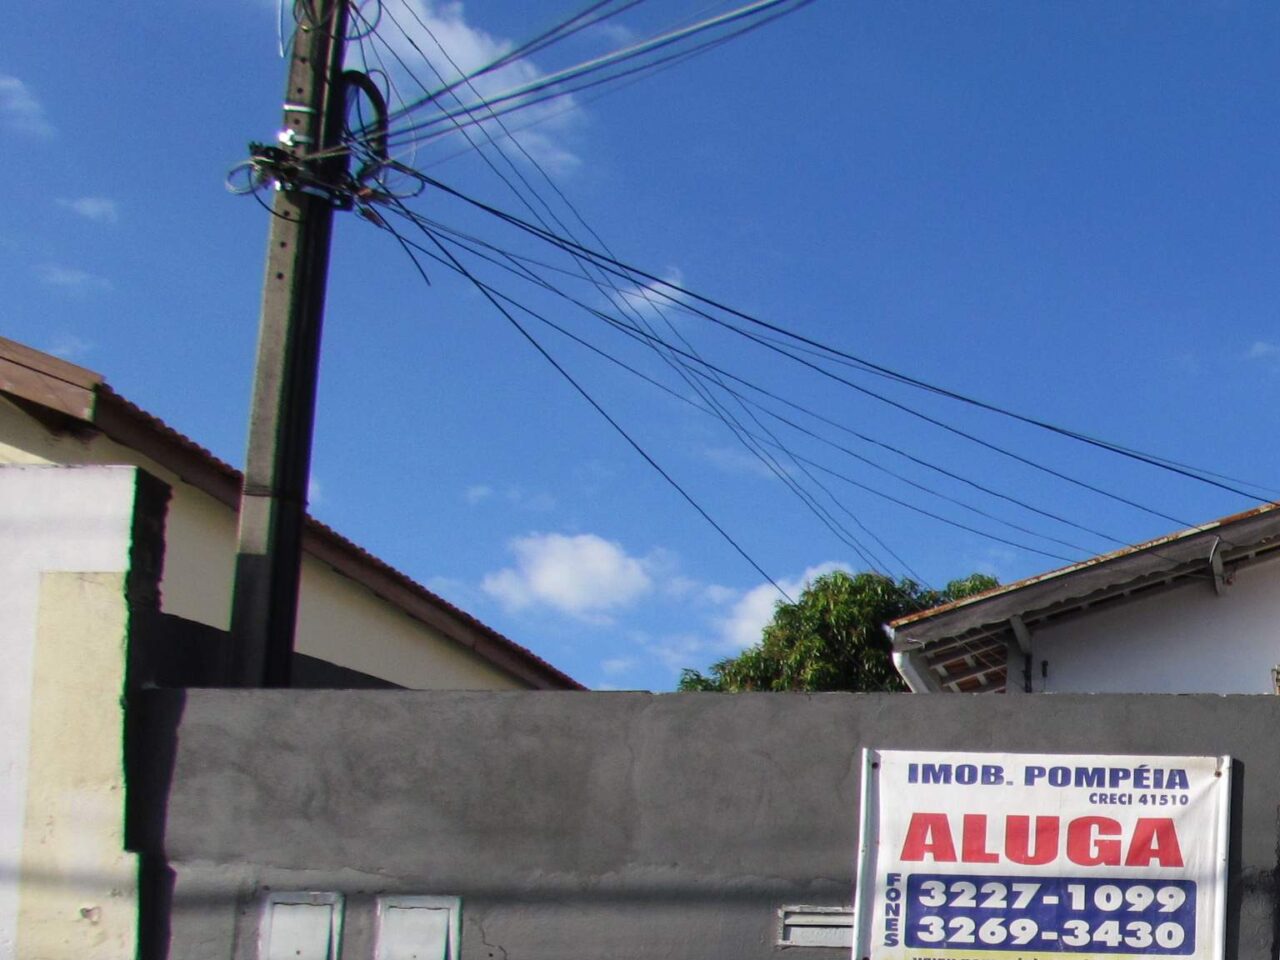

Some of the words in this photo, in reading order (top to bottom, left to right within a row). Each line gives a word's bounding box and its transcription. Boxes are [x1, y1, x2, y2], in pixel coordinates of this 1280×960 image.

[907, 763, 1014, 786] IMOB.
[1024, 764, 1190, 790] POMPÉIA
[1089, 792, 1133, 805] CRECI
[1138, 793, 1189, 806] 41510
[900, 812, 1185, 868] ALUGA
[883, 873, 902, 948] FONES
[918, 880, 1186, 913] 3227-1099
[916, 916, 1185, 949] 3269-3430
